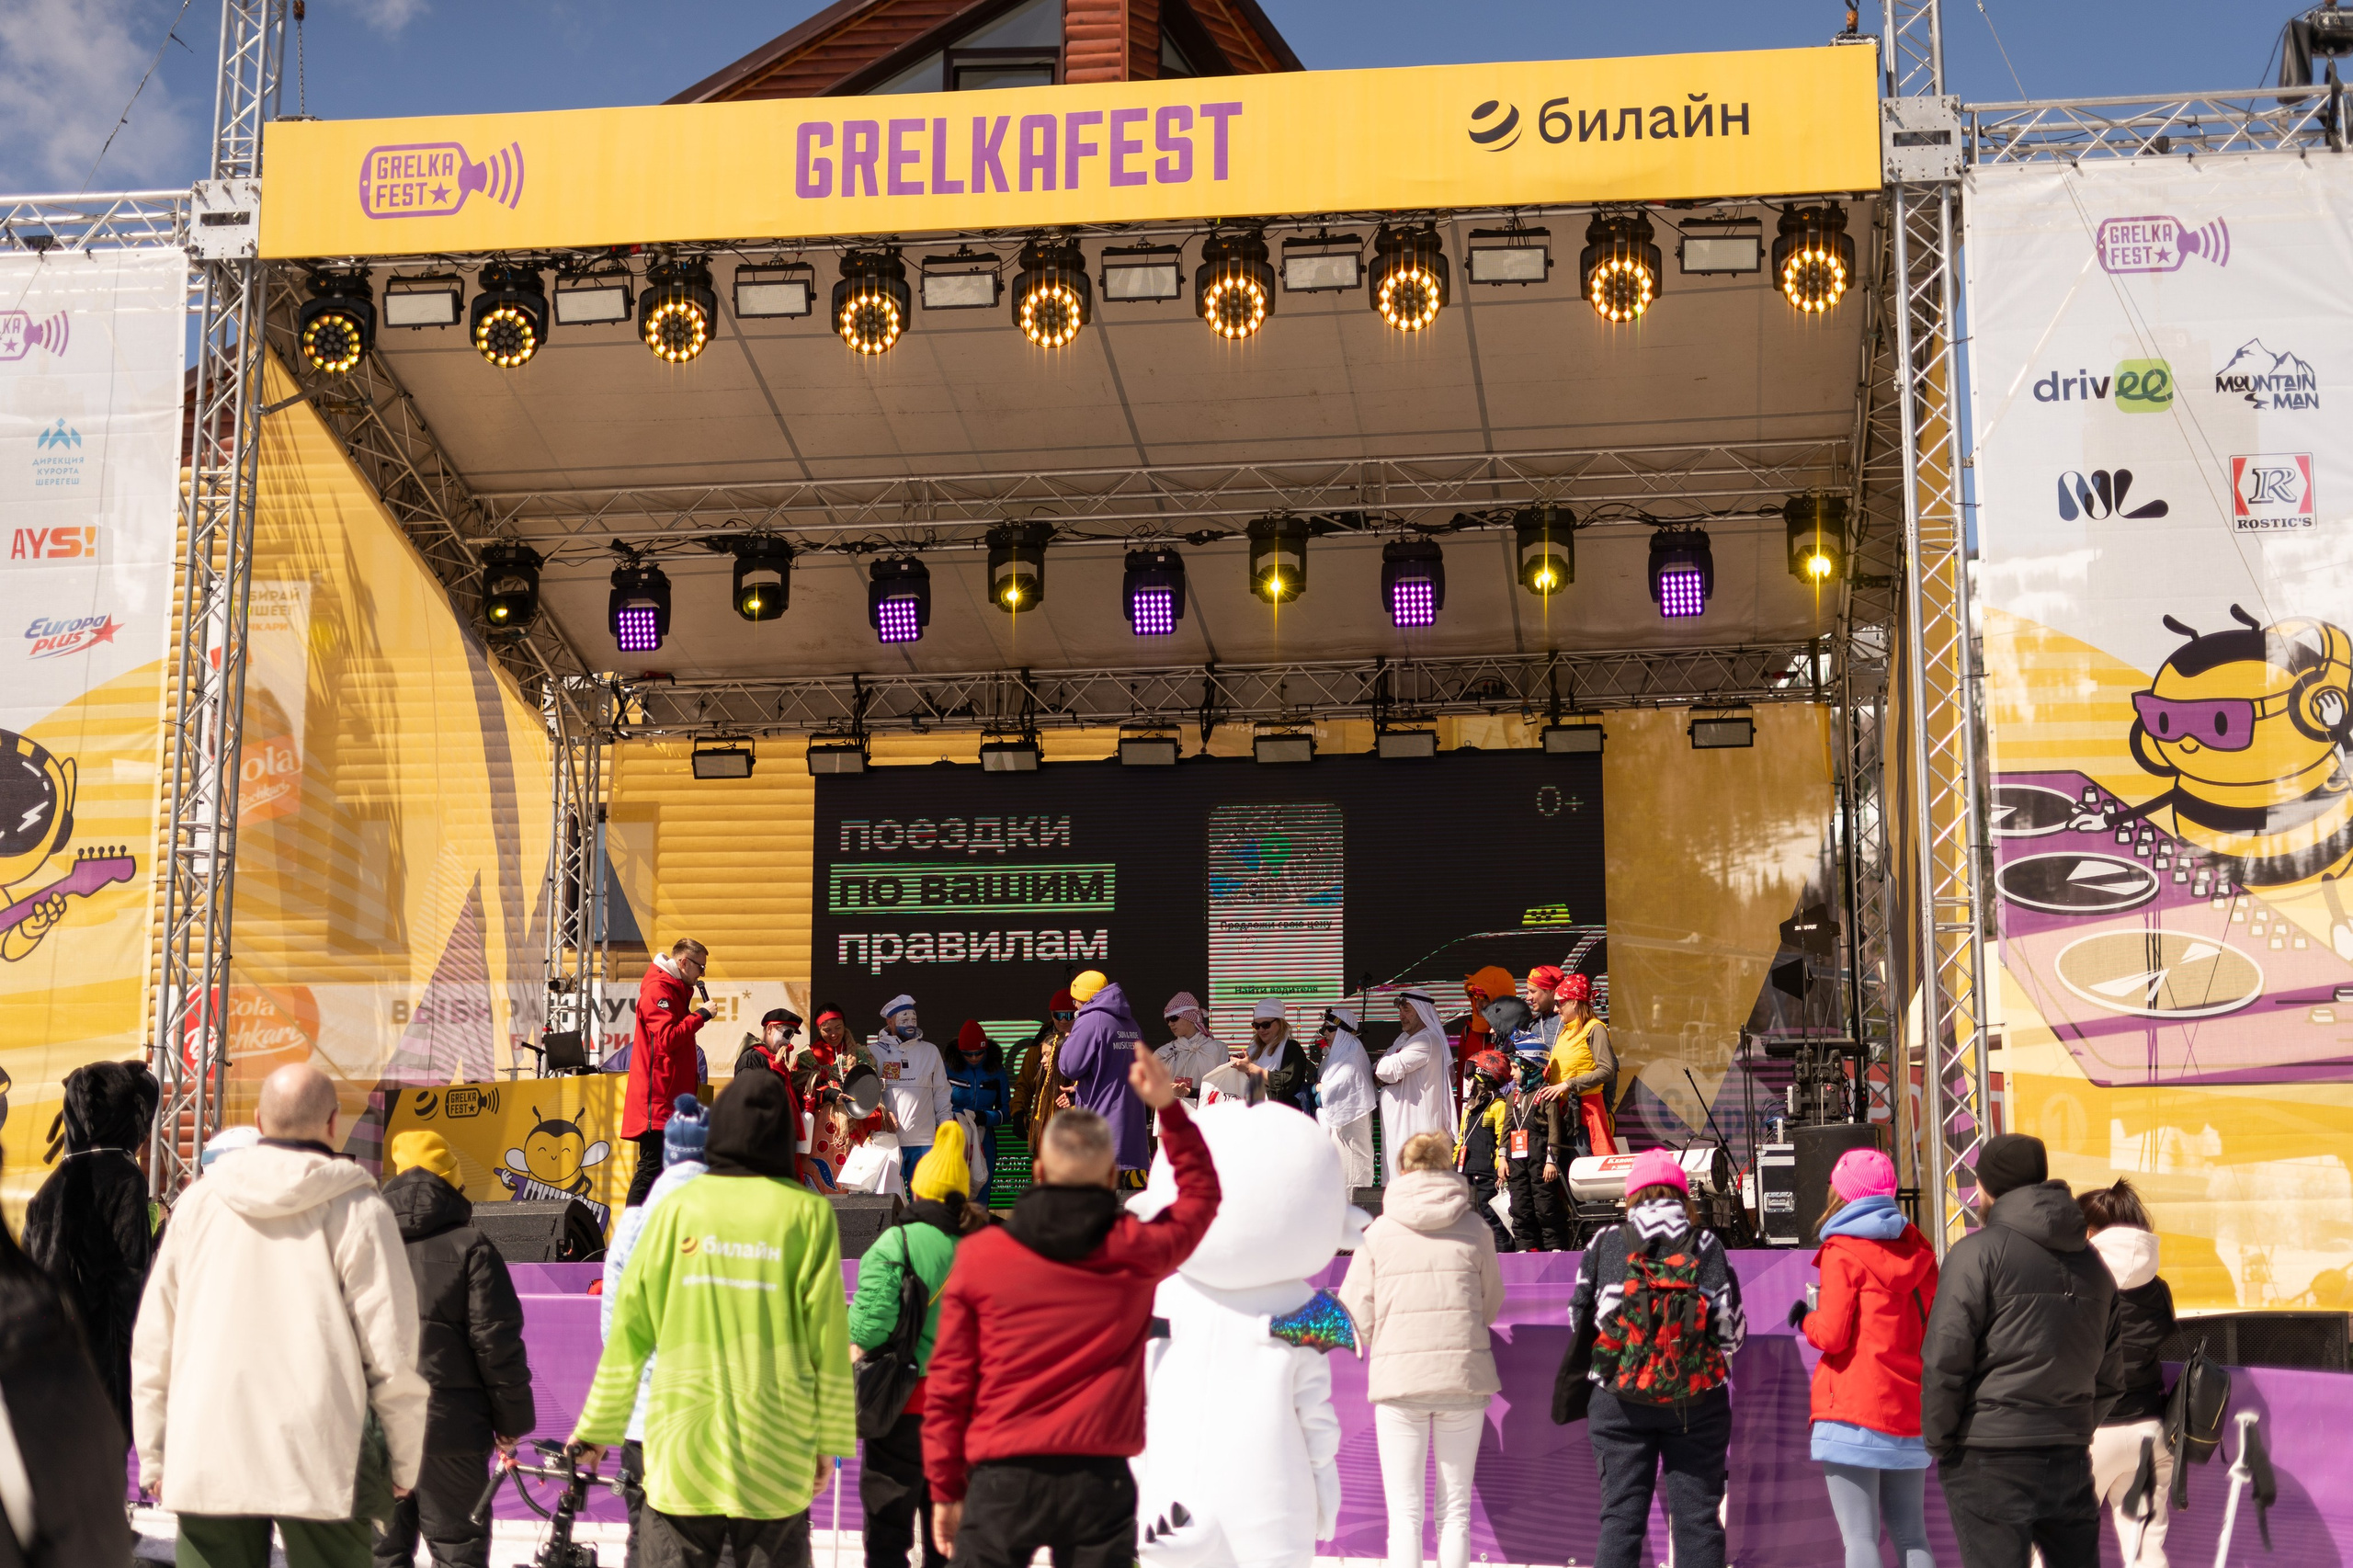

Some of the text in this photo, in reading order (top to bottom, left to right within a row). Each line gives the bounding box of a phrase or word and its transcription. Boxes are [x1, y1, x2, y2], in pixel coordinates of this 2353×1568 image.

[1539, 92, 1750, 144] билайн
[795, 101, 1244, 199] GRELKAFEST
[377, 153, 454, 180] GRELKA
[376, 182, 428, 208] FEST
[2109, 223, 2173, 244] GRELKA
[2110, 245, 2153, 266] FEST
[2033, 368, 2174, 403] drivee
[2216, 373, 2317, 393] MOUNTAIN
[2274, 392, 2320, 410] MAN
[32, 456, 85, 466] ДИРЕКЦИЯ
[37, 467, 79, 476] КУРОРТА
[35, 477, 80, 486] ШЕРЕГЕШ
[2236, 517, 2313, 530] ROSTIC'S
[10, 526, 97, 560] AYS!
[24, 615, 107, 640] Europa
[1536, 785, 1585, 816] 0+
[840, 815, 1071, 855] поездки
[839, 871, 1104, 905] по вашим
[838, 929, 1108, 975] правилам
[450, 1092, 477, 1103] GRELKA
[450, 1104, 469, 1115] FEST
[702, 1234, 781, 1262] билайн
